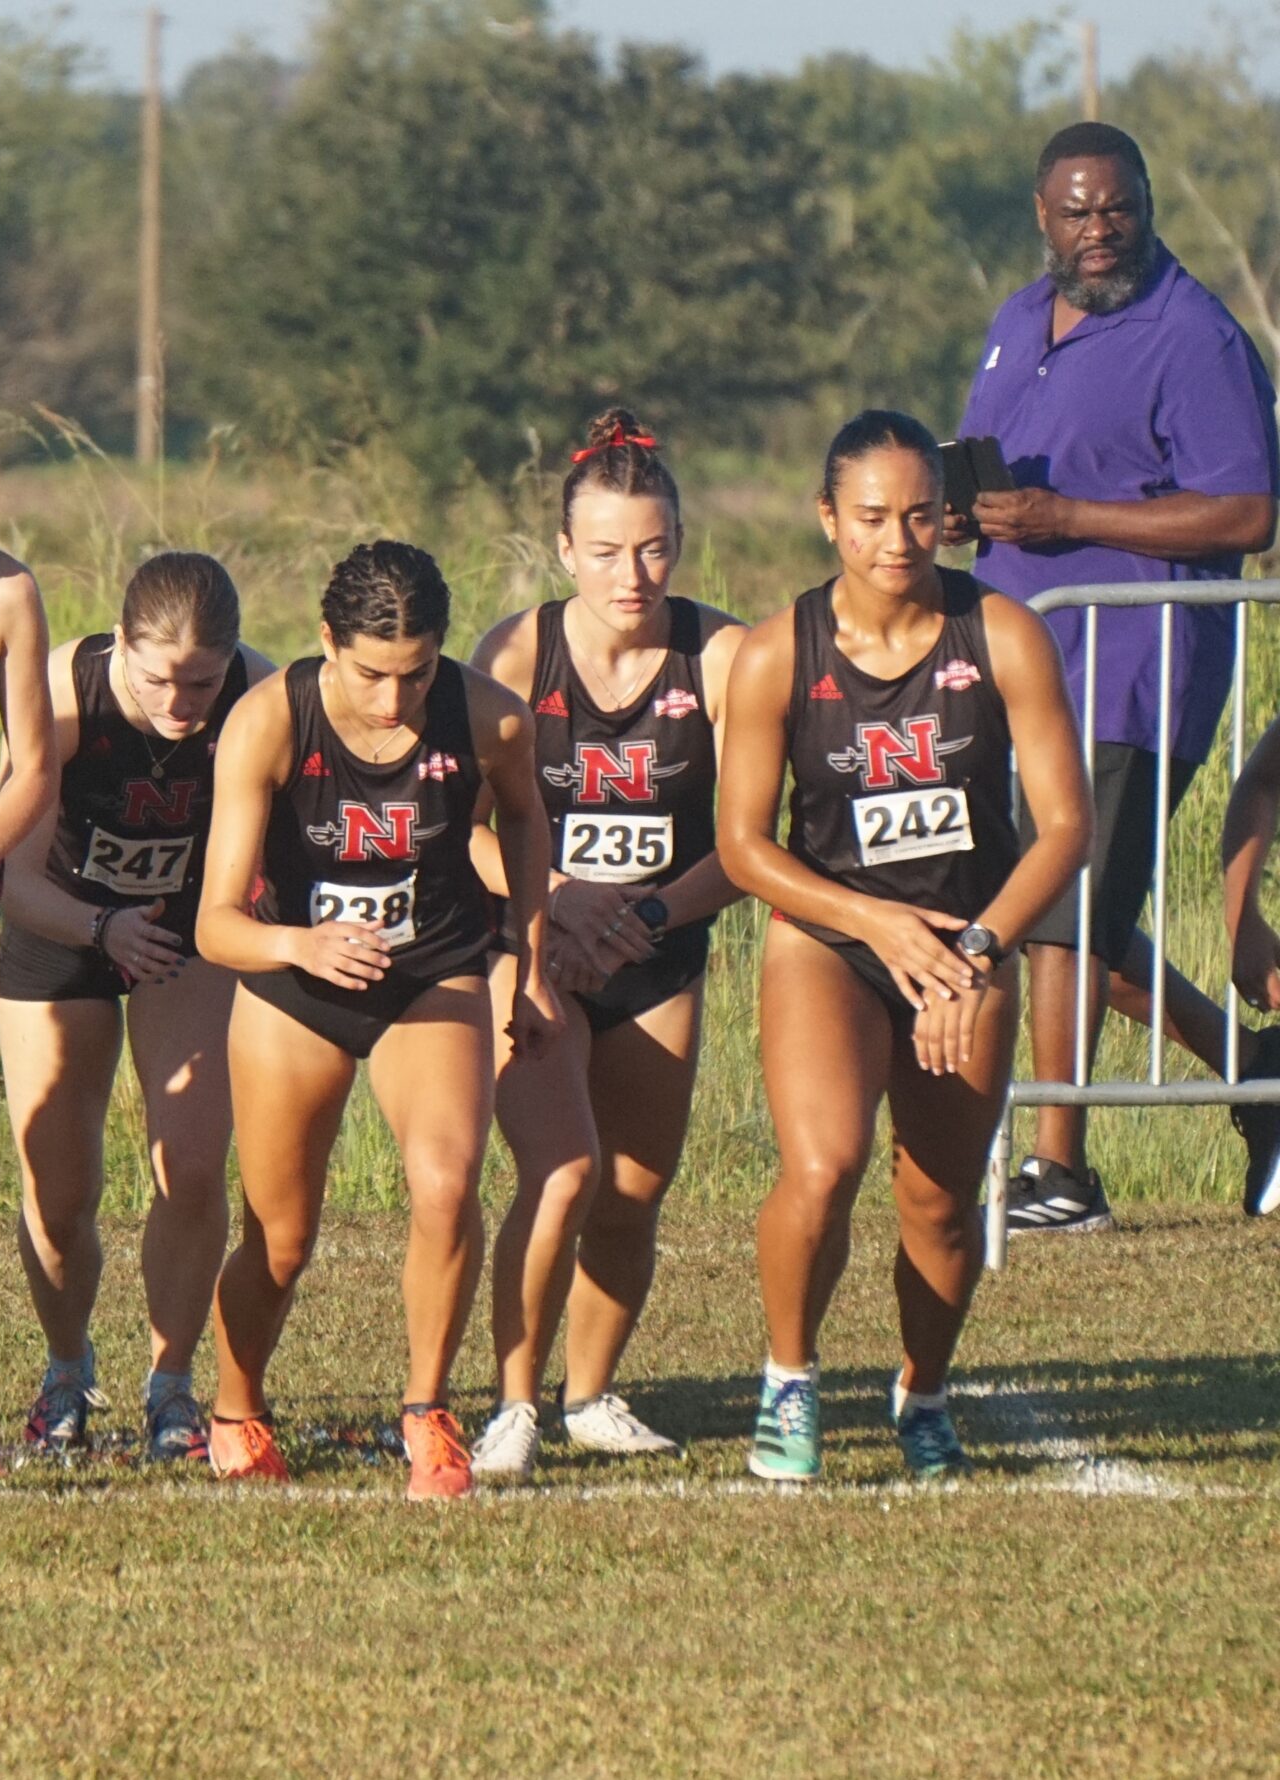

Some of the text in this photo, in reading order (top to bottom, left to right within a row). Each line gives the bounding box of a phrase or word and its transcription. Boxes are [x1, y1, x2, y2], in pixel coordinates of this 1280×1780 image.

[573, 739, 658, 803] N
[856, 713, 946, 790] N
[122, 778, 199, 825] N
[864, 794, 965, 848] 242
[335, 800, 420, 862] N
[570, 823, 666, 868] 235
[93, 839, 188, 880] 247
[315, 891, 409, 929] 238
